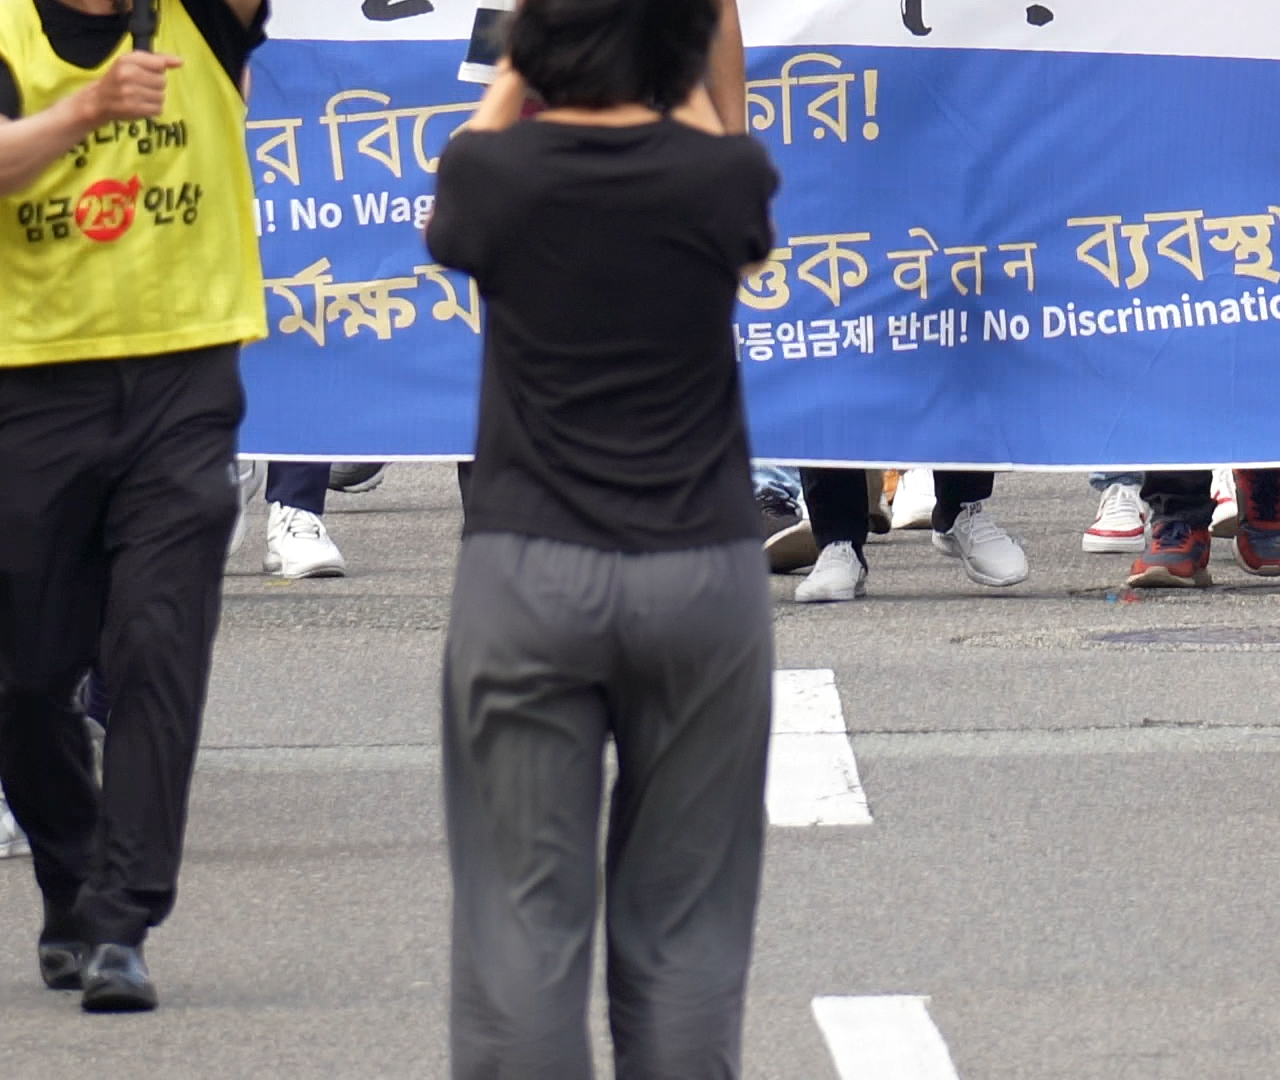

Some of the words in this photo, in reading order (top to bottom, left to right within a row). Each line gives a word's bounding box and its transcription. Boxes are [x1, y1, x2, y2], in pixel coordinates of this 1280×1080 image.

[17, 194, 73, 243] 임금
[144, 182, 202, 226] 인상
[290, 196, 343, 232] No
[352, 190, 436, 231] Wag
[888, 306, 969, 352] 반대!
[983, 308, 1030, 342] No
